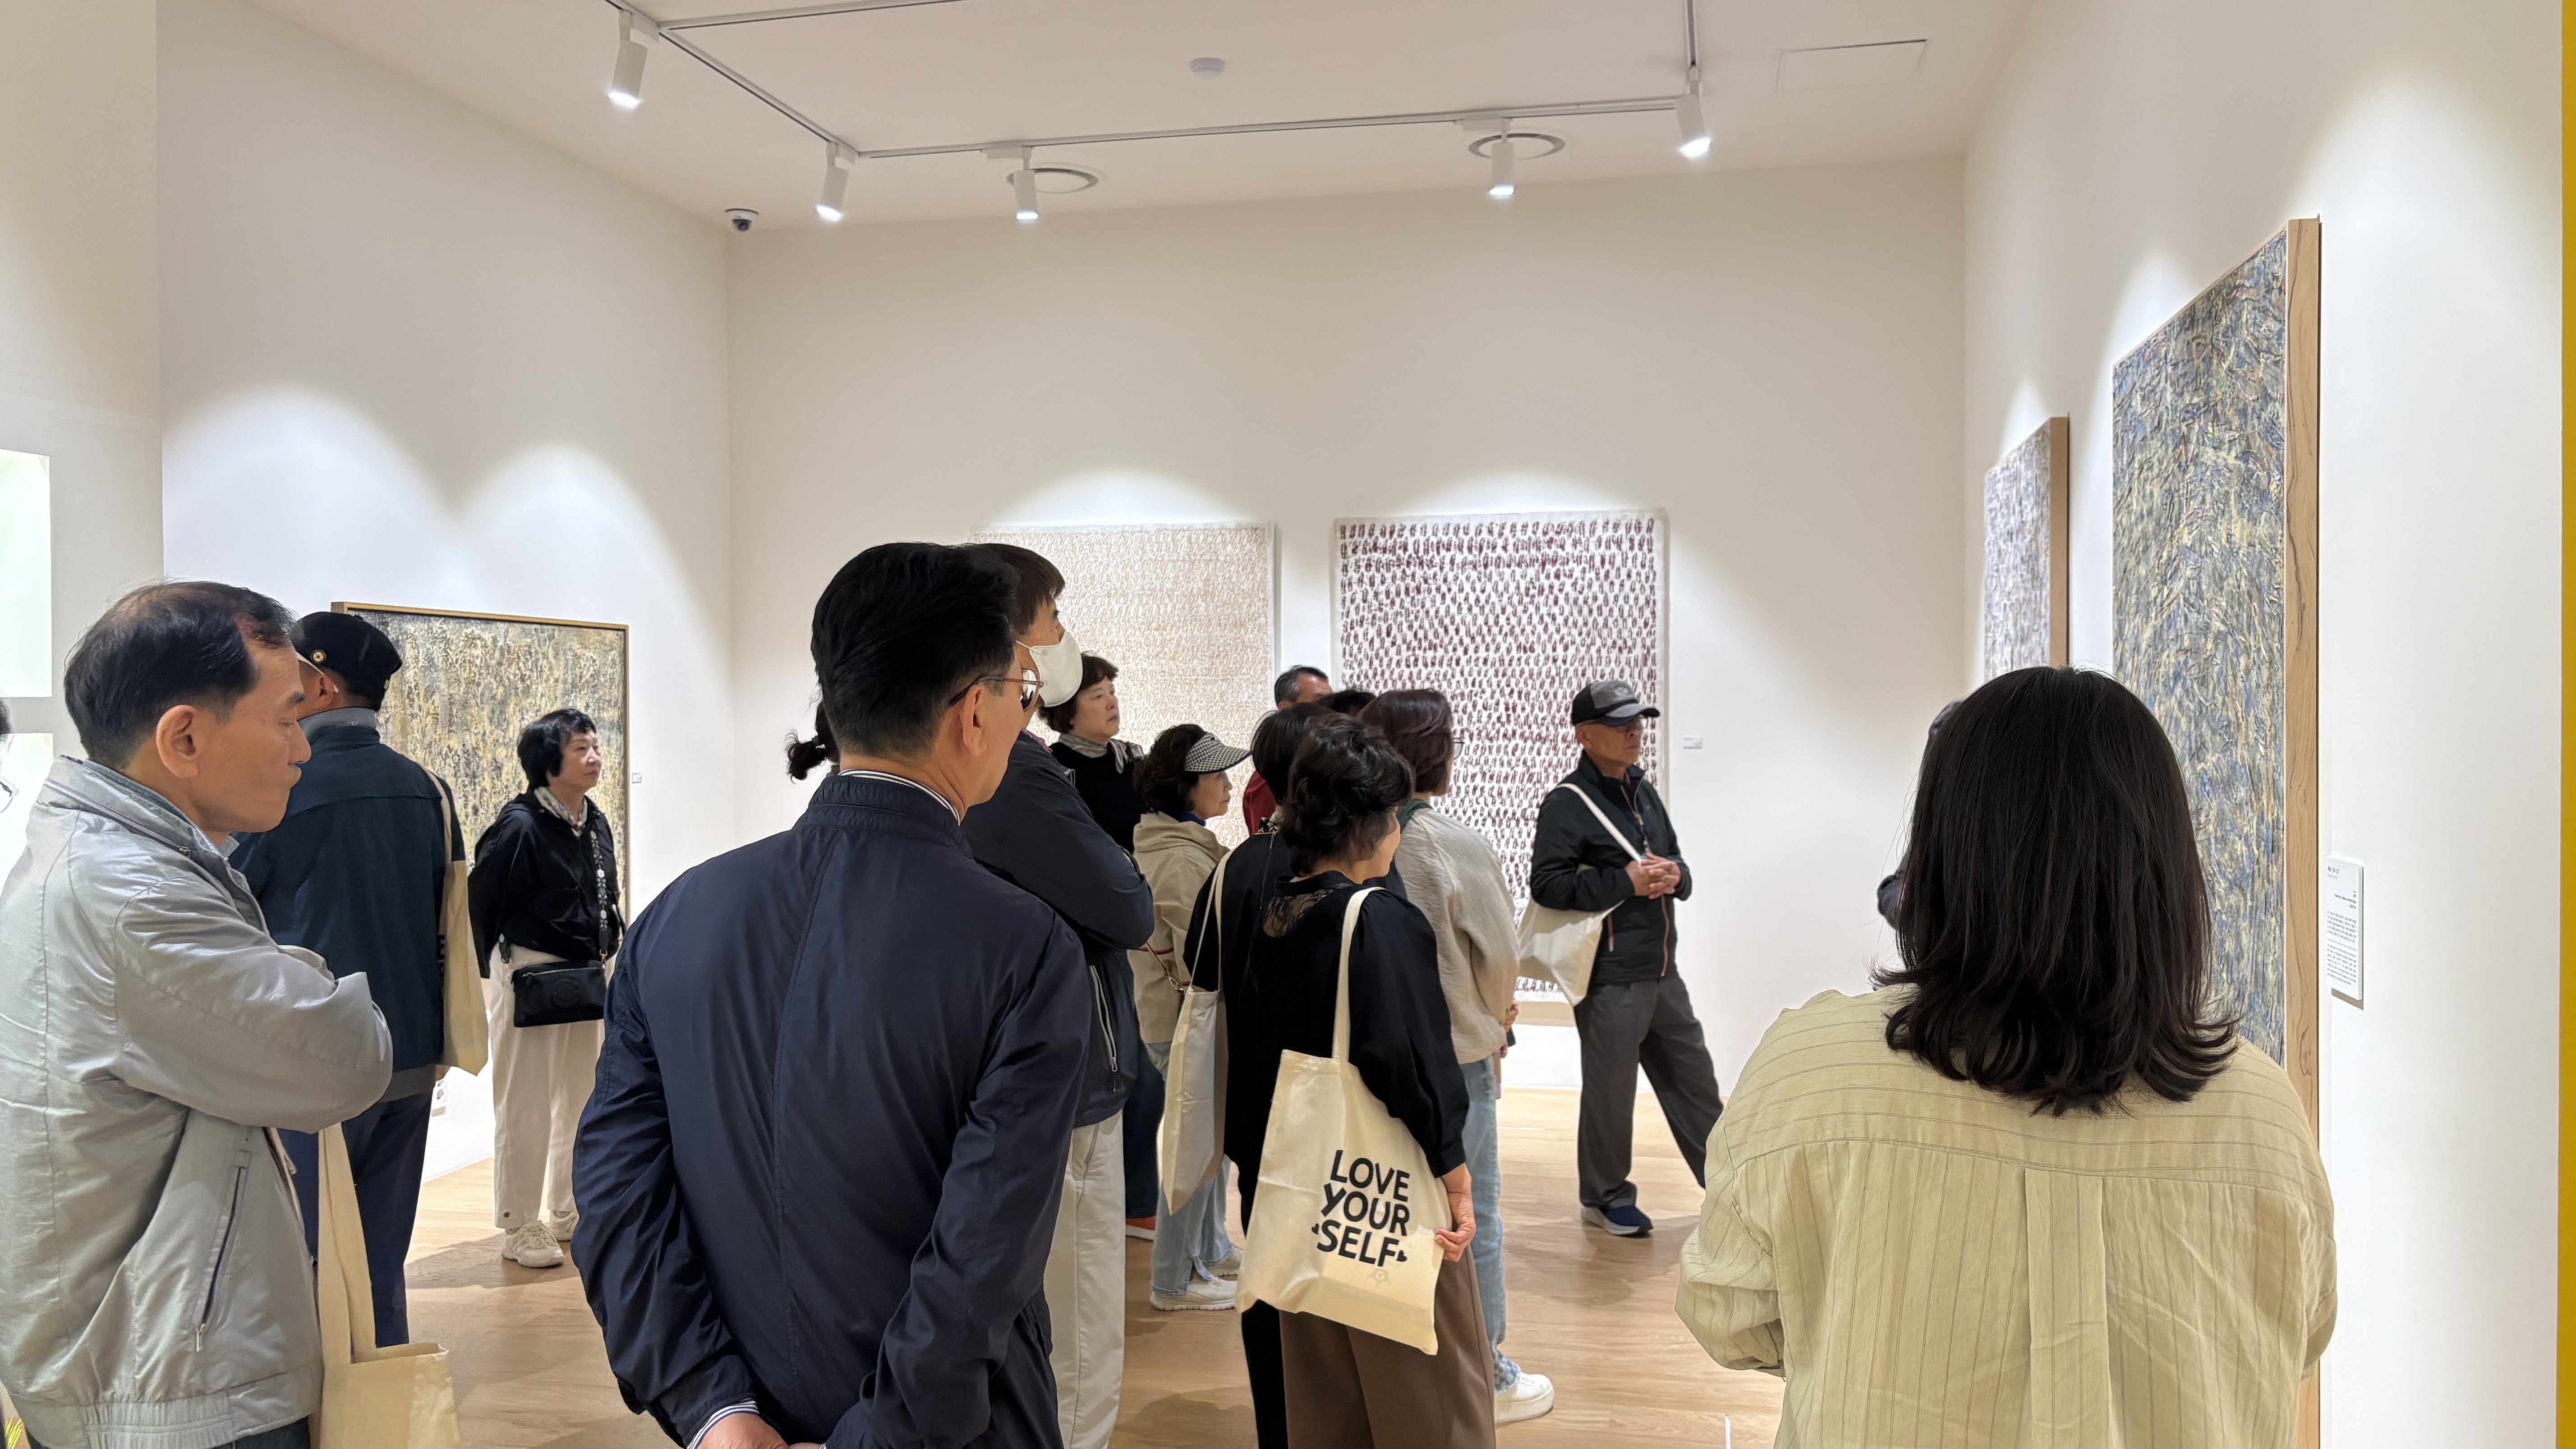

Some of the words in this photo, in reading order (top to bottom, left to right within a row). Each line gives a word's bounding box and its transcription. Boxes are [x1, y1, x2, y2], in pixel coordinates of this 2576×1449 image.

[1330, 1150, 1410, 1202] LOVE
[1321, 1183, 1410, 1236] YOUR
[1317, 1219, 1400, 1266] SELF
